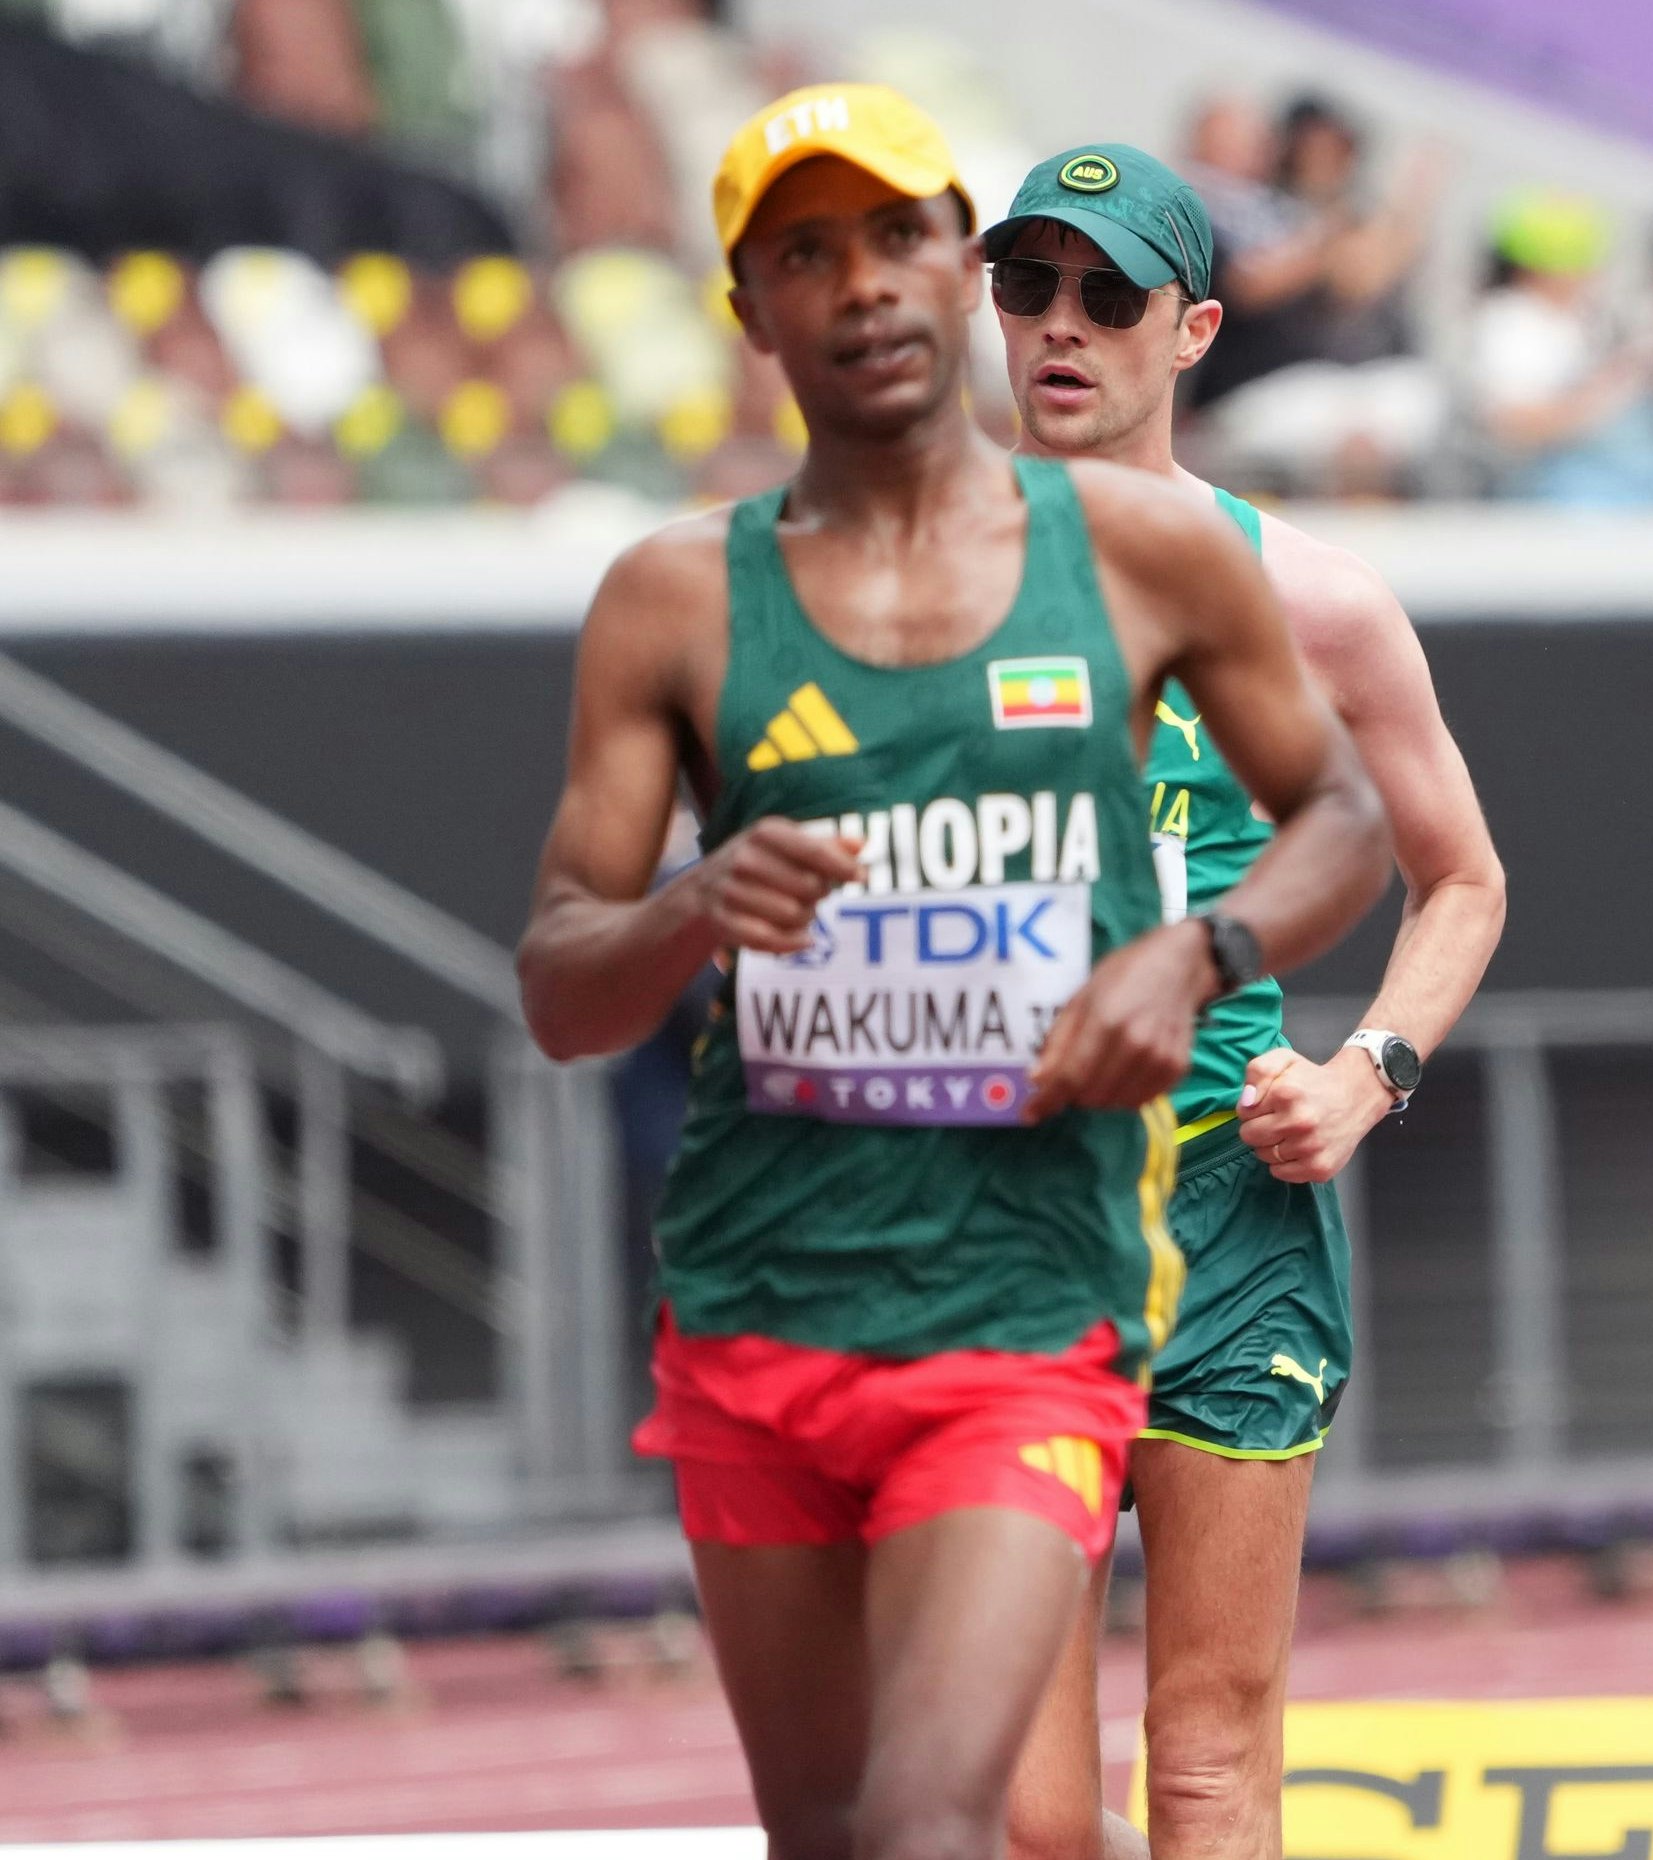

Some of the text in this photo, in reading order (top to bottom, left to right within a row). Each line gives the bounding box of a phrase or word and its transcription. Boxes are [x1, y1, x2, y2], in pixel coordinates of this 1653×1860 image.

[765, 96, 849, 154] ETH
[1072, 166, 1104, 181] AUS
[797, 790, 1101, 897] HIOPIA
[838, 896, 1057, 964] TDK
[752, 986, 1015, 1056] WAKUMA
